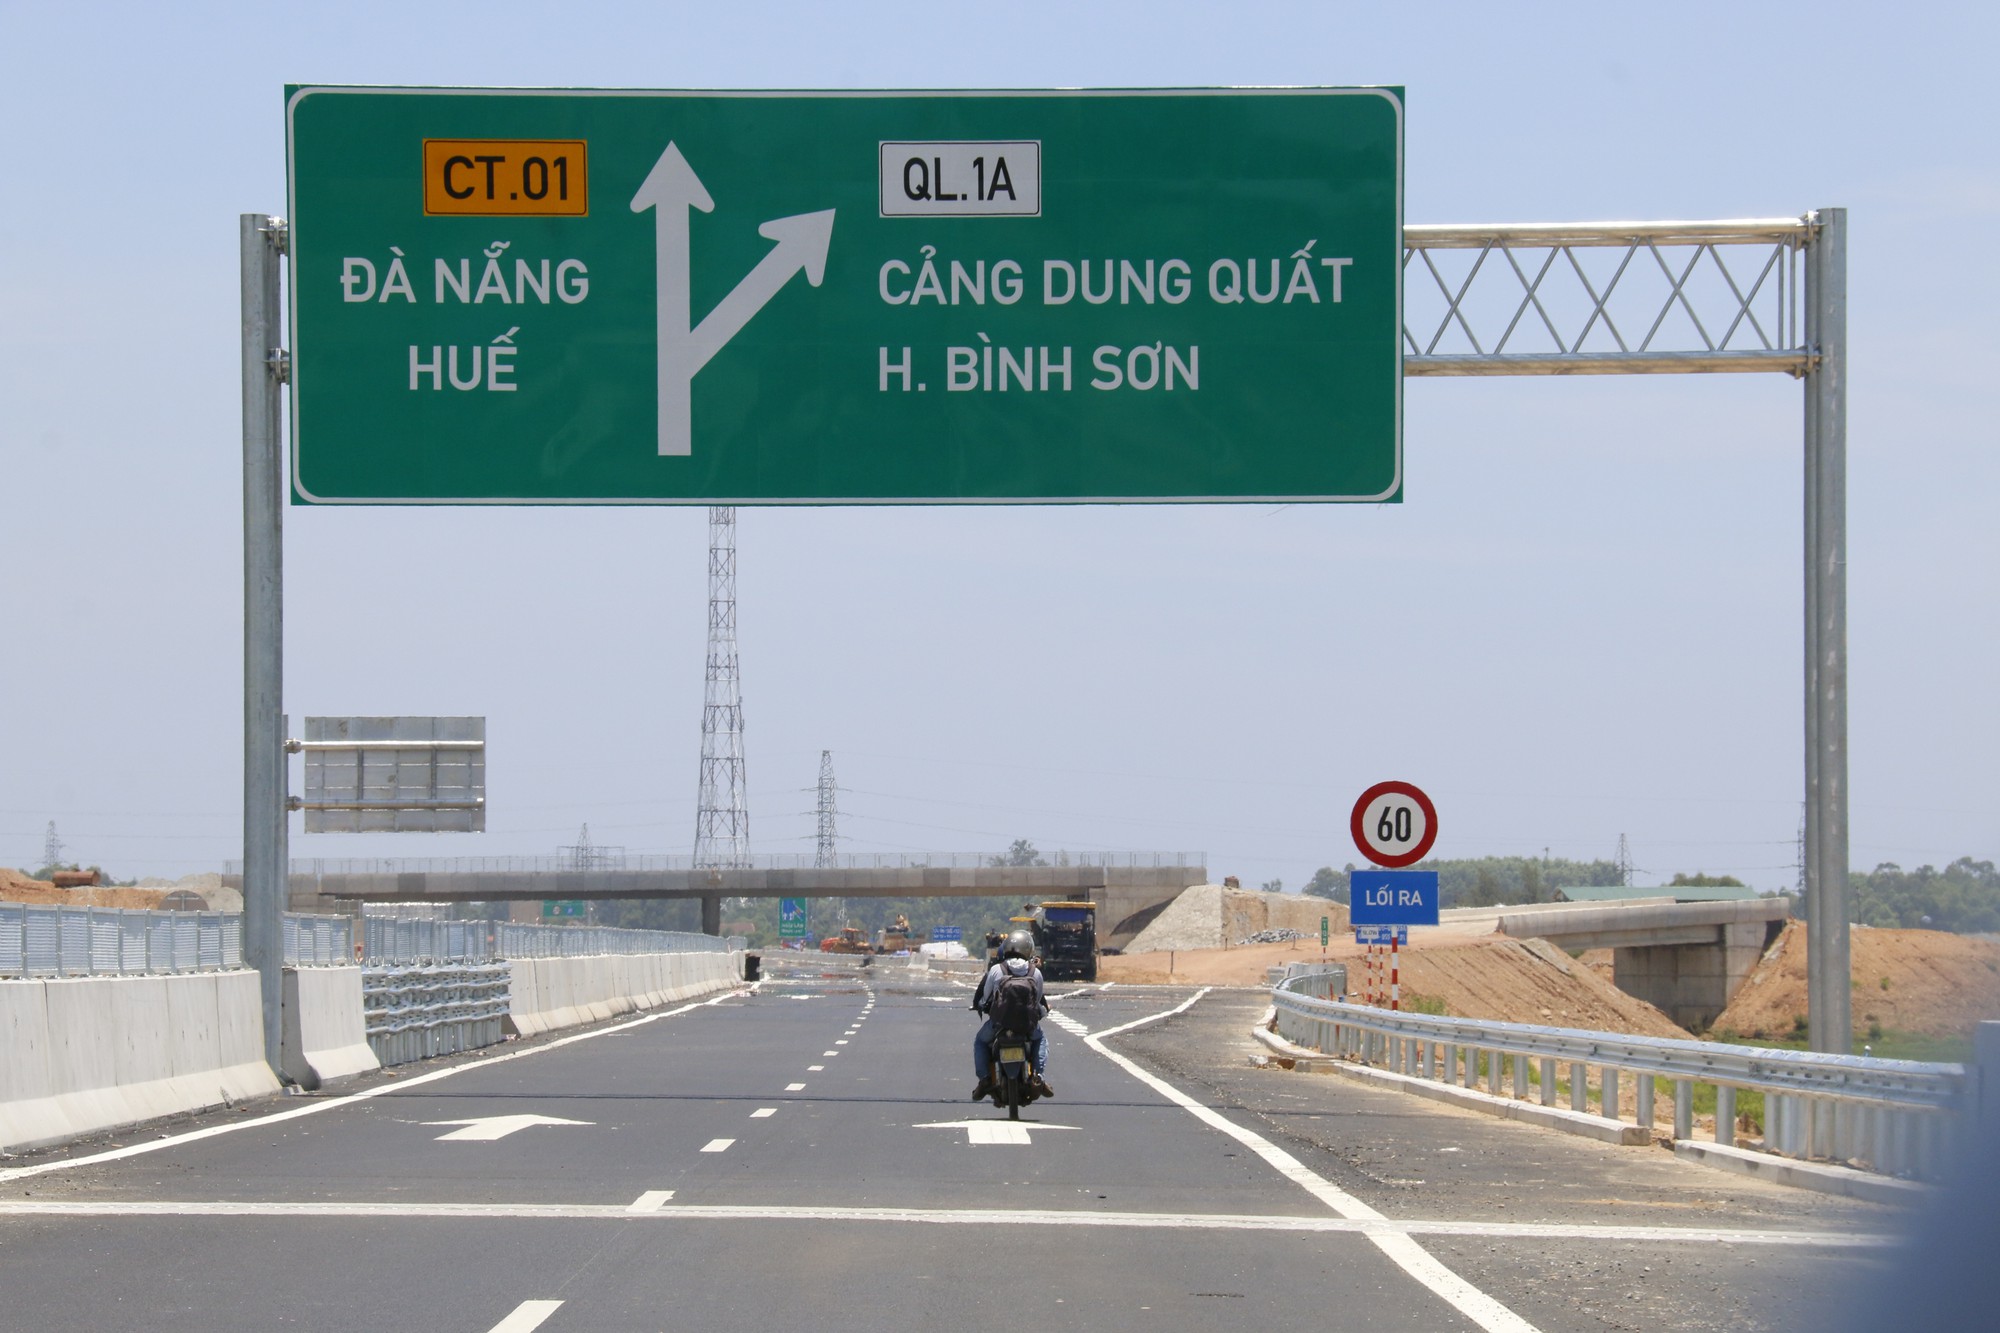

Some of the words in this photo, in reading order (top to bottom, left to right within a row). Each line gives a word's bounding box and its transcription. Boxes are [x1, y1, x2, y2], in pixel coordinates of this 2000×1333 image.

[443, 155, 568, 201] CT.01
[903, 156, 1017, 201] QL.1A
[340, 246, 416, 303] ĐÀ
[434, 241, 589, 304] NẴNG
[879, 244, 1024, 305] CẢNG
[1043, 259, 1191, 304] DUNG
[1208, 239, 1353, 304] QUẤT
[409, 327, 520, 391] HUẾ
[879, 347, 927, 391] H.
[947, 332, 1072, 391] BÌNH
[1090, 341, 1199, 390] SƠN
[1378, 806, 1412, 842] 60
[1366, 884, 1393, 906] LỐI
[1398, 890, 1423, 906] RA
